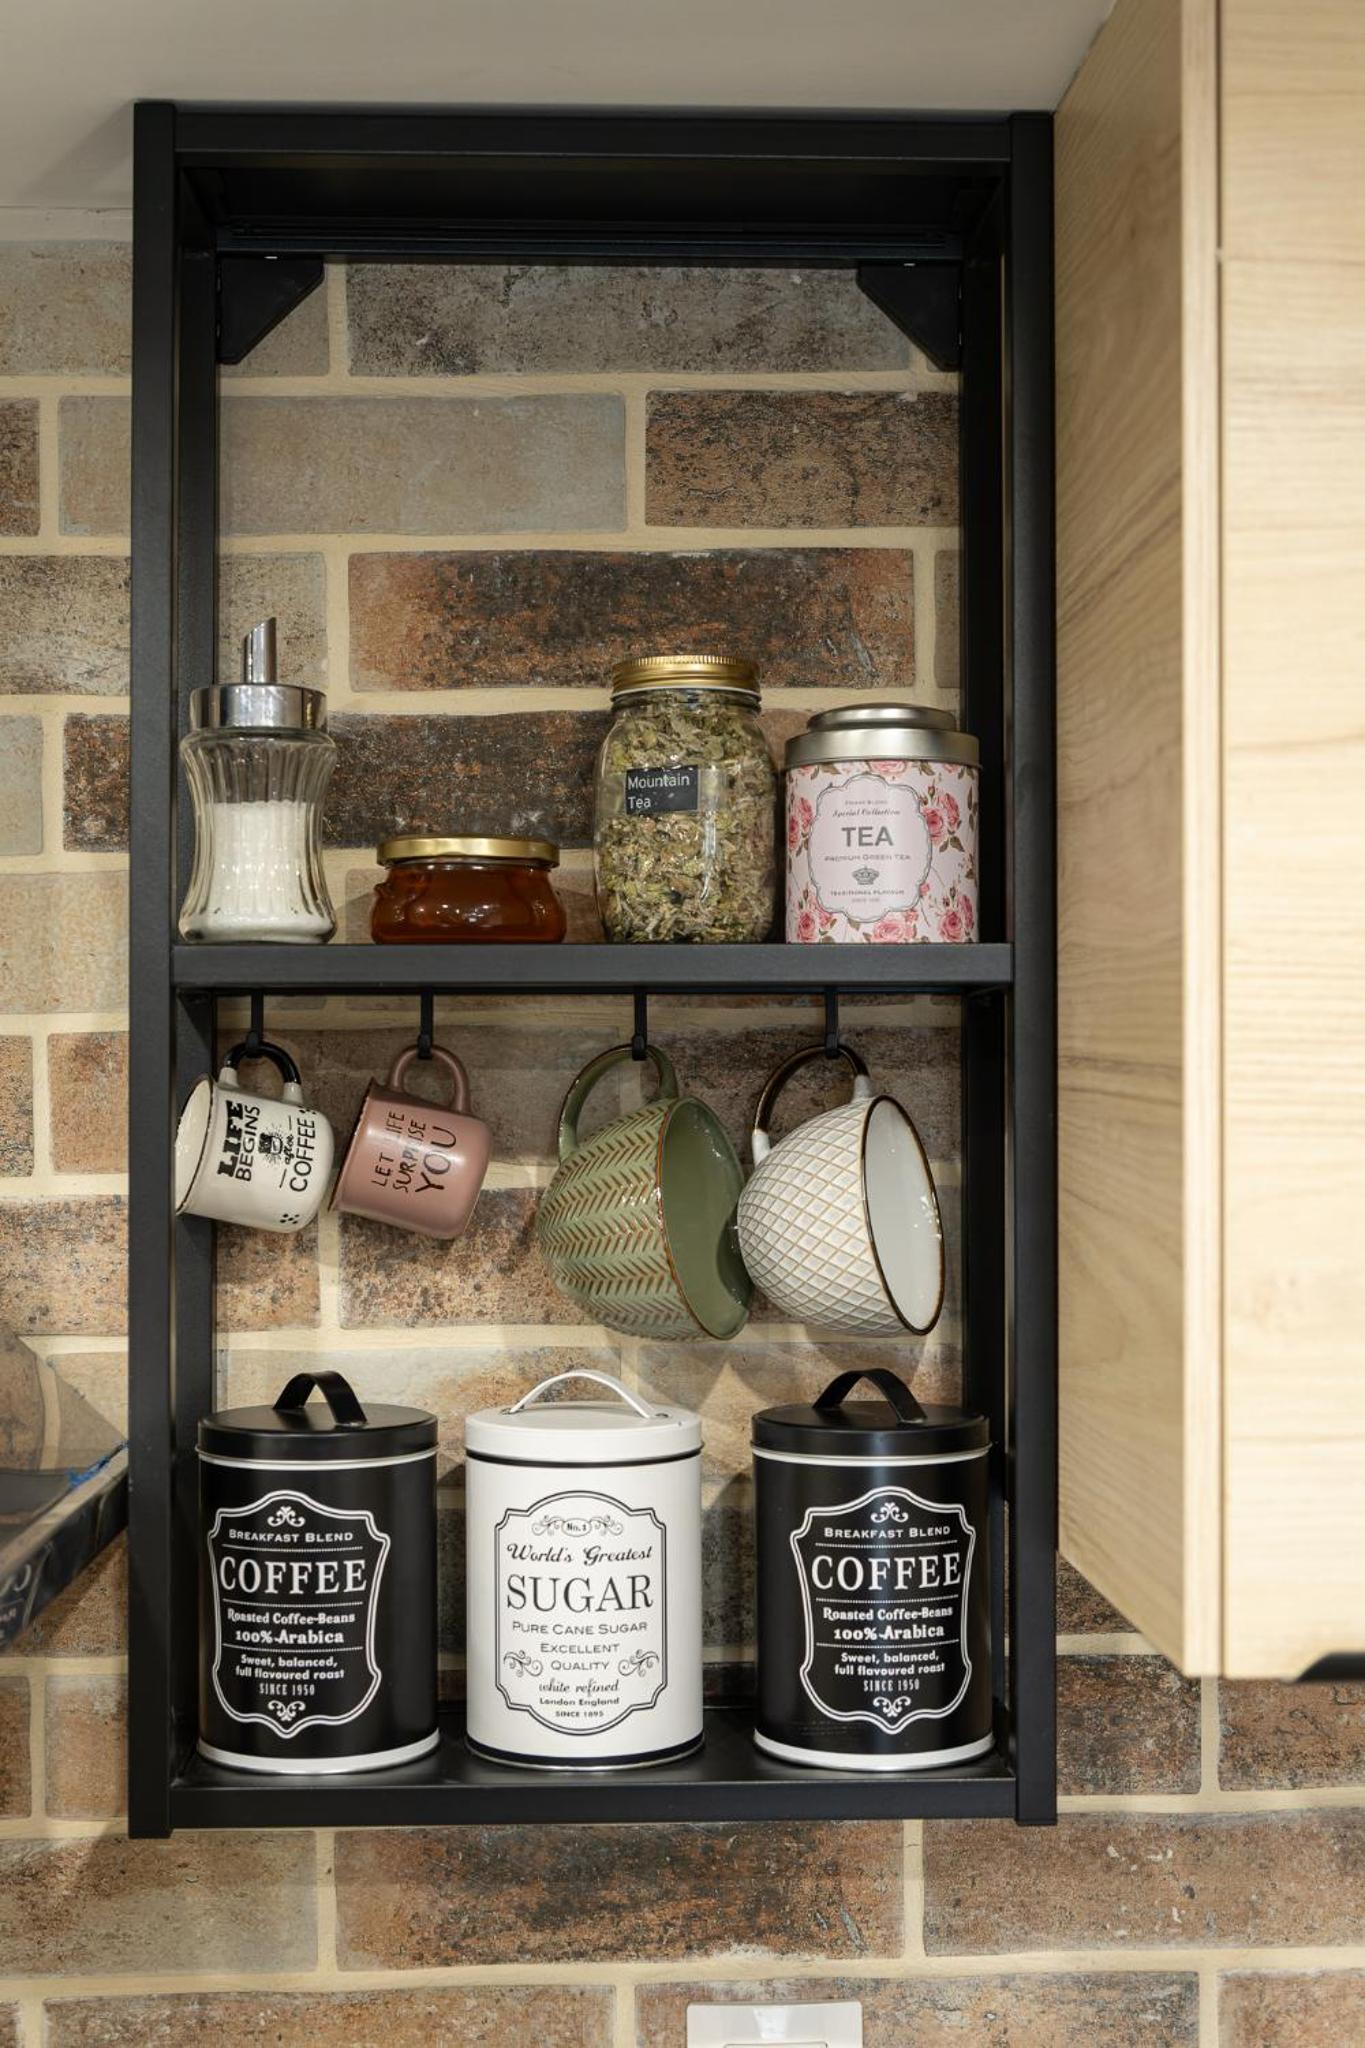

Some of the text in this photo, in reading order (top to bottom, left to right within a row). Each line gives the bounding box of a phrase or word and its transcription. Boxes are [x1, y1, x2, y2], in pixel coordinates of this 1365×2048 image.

[627, 774, 690, 790] Mountain
[628, 796, 651, 809] Tea
[841, 826, 894, 848] TEA
[217, 1100, 244, 1177] LIFE
[235, 1104, 261, 1182] BEGINS
[289, 1117, 316, 1192] COFFEE
[370, 1111, 405, 1187] LET IFE
[392, 1120, 427, 1193] SURPISE
[414, 1126, 457, 1193] YOU
[228, 1528, 354, 1543] BREAKFAST BLEND
[823, 1526, 951, 1539] BREAKFAST BLEND
[507, 1543, 653, 1567] World's Greatest
[219, 1556, 367, 1595] COFFEE
[811, 1552, 962, 1591] COFFEE
[507, 1574, 654, 1614] SUGAR
[227, 1608, 270, 1624] Roasted
[822, 1606, 874, 1622] Roasted
[512, 1621, 649, 1635] PURE CANE SUGAR
[878, 1624, 945, 1641] Arabica
[274, 1629, 345, 1645] Arabica
[540, 1643, 621, 1654] EXCELLENT
[240, 1653, 338, 1668] Sweet, balanced,
[550, 1660, 611, 1671] QUALITY
[840, 1650, 940, 1665] Sweet, balanced,
[235, 1665, 345, 1680] full flavoured roast
[834, 1662, 946, 1676] full flavoured roast
[259, 1682, 316, 1696] SINCE 1950
[538, 1677, 620, 1698] white refined
[863, 1678, 920, 1692] SINCE 1950
[539, 1697, 621, 1707] London England
[555, 1710, 580, 1718] SINCE
